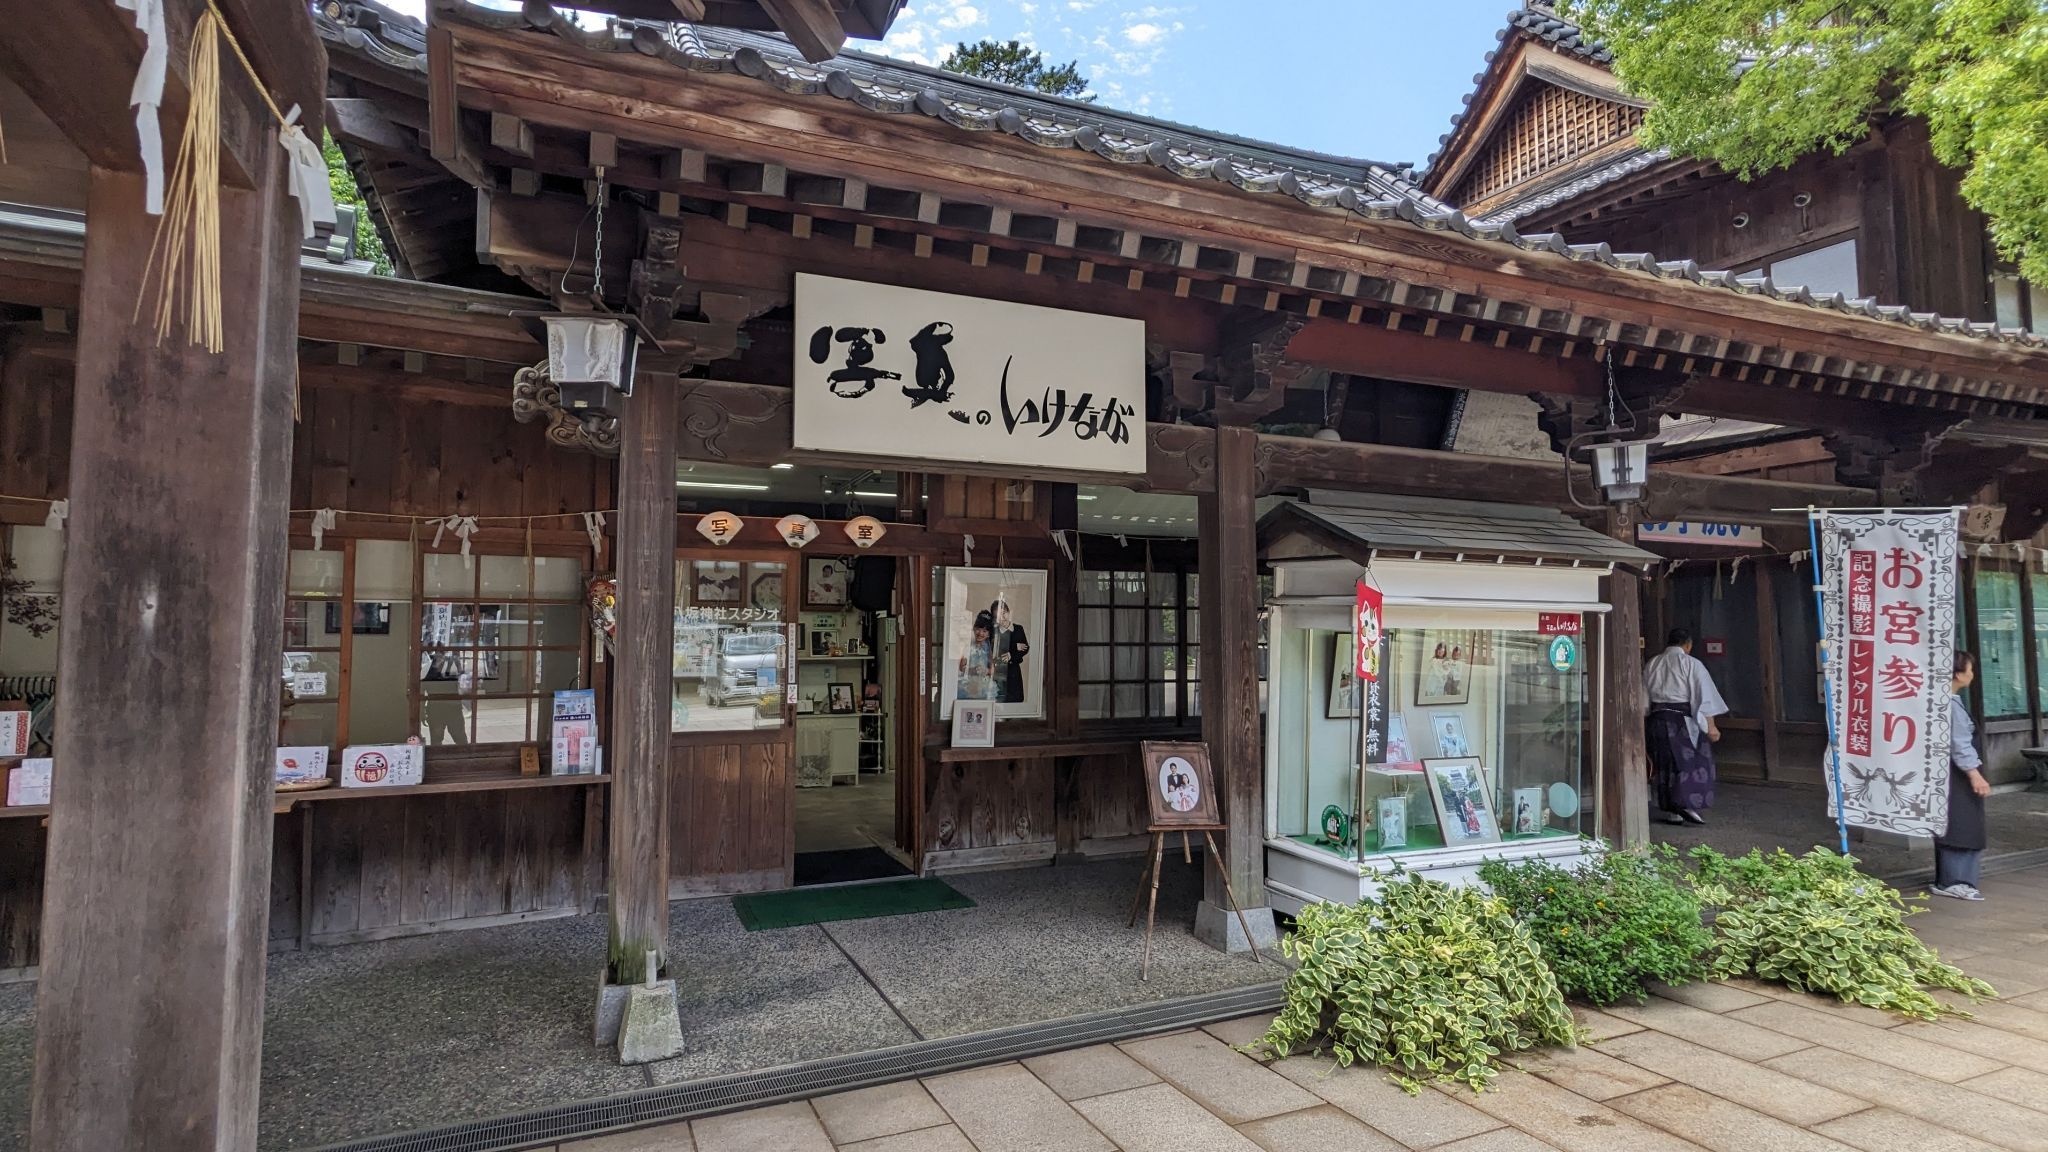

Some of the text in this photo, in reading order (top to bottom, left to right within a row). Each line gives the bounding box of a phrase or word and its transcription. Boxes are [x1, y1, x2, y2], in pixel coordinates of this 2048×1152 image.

[711, 519, 873, 540] 写 真 室
[1849, 552, 1873, 753] 記念撮影 レンタル衣装
[1878, 546, 1926, 755] お宮参り
